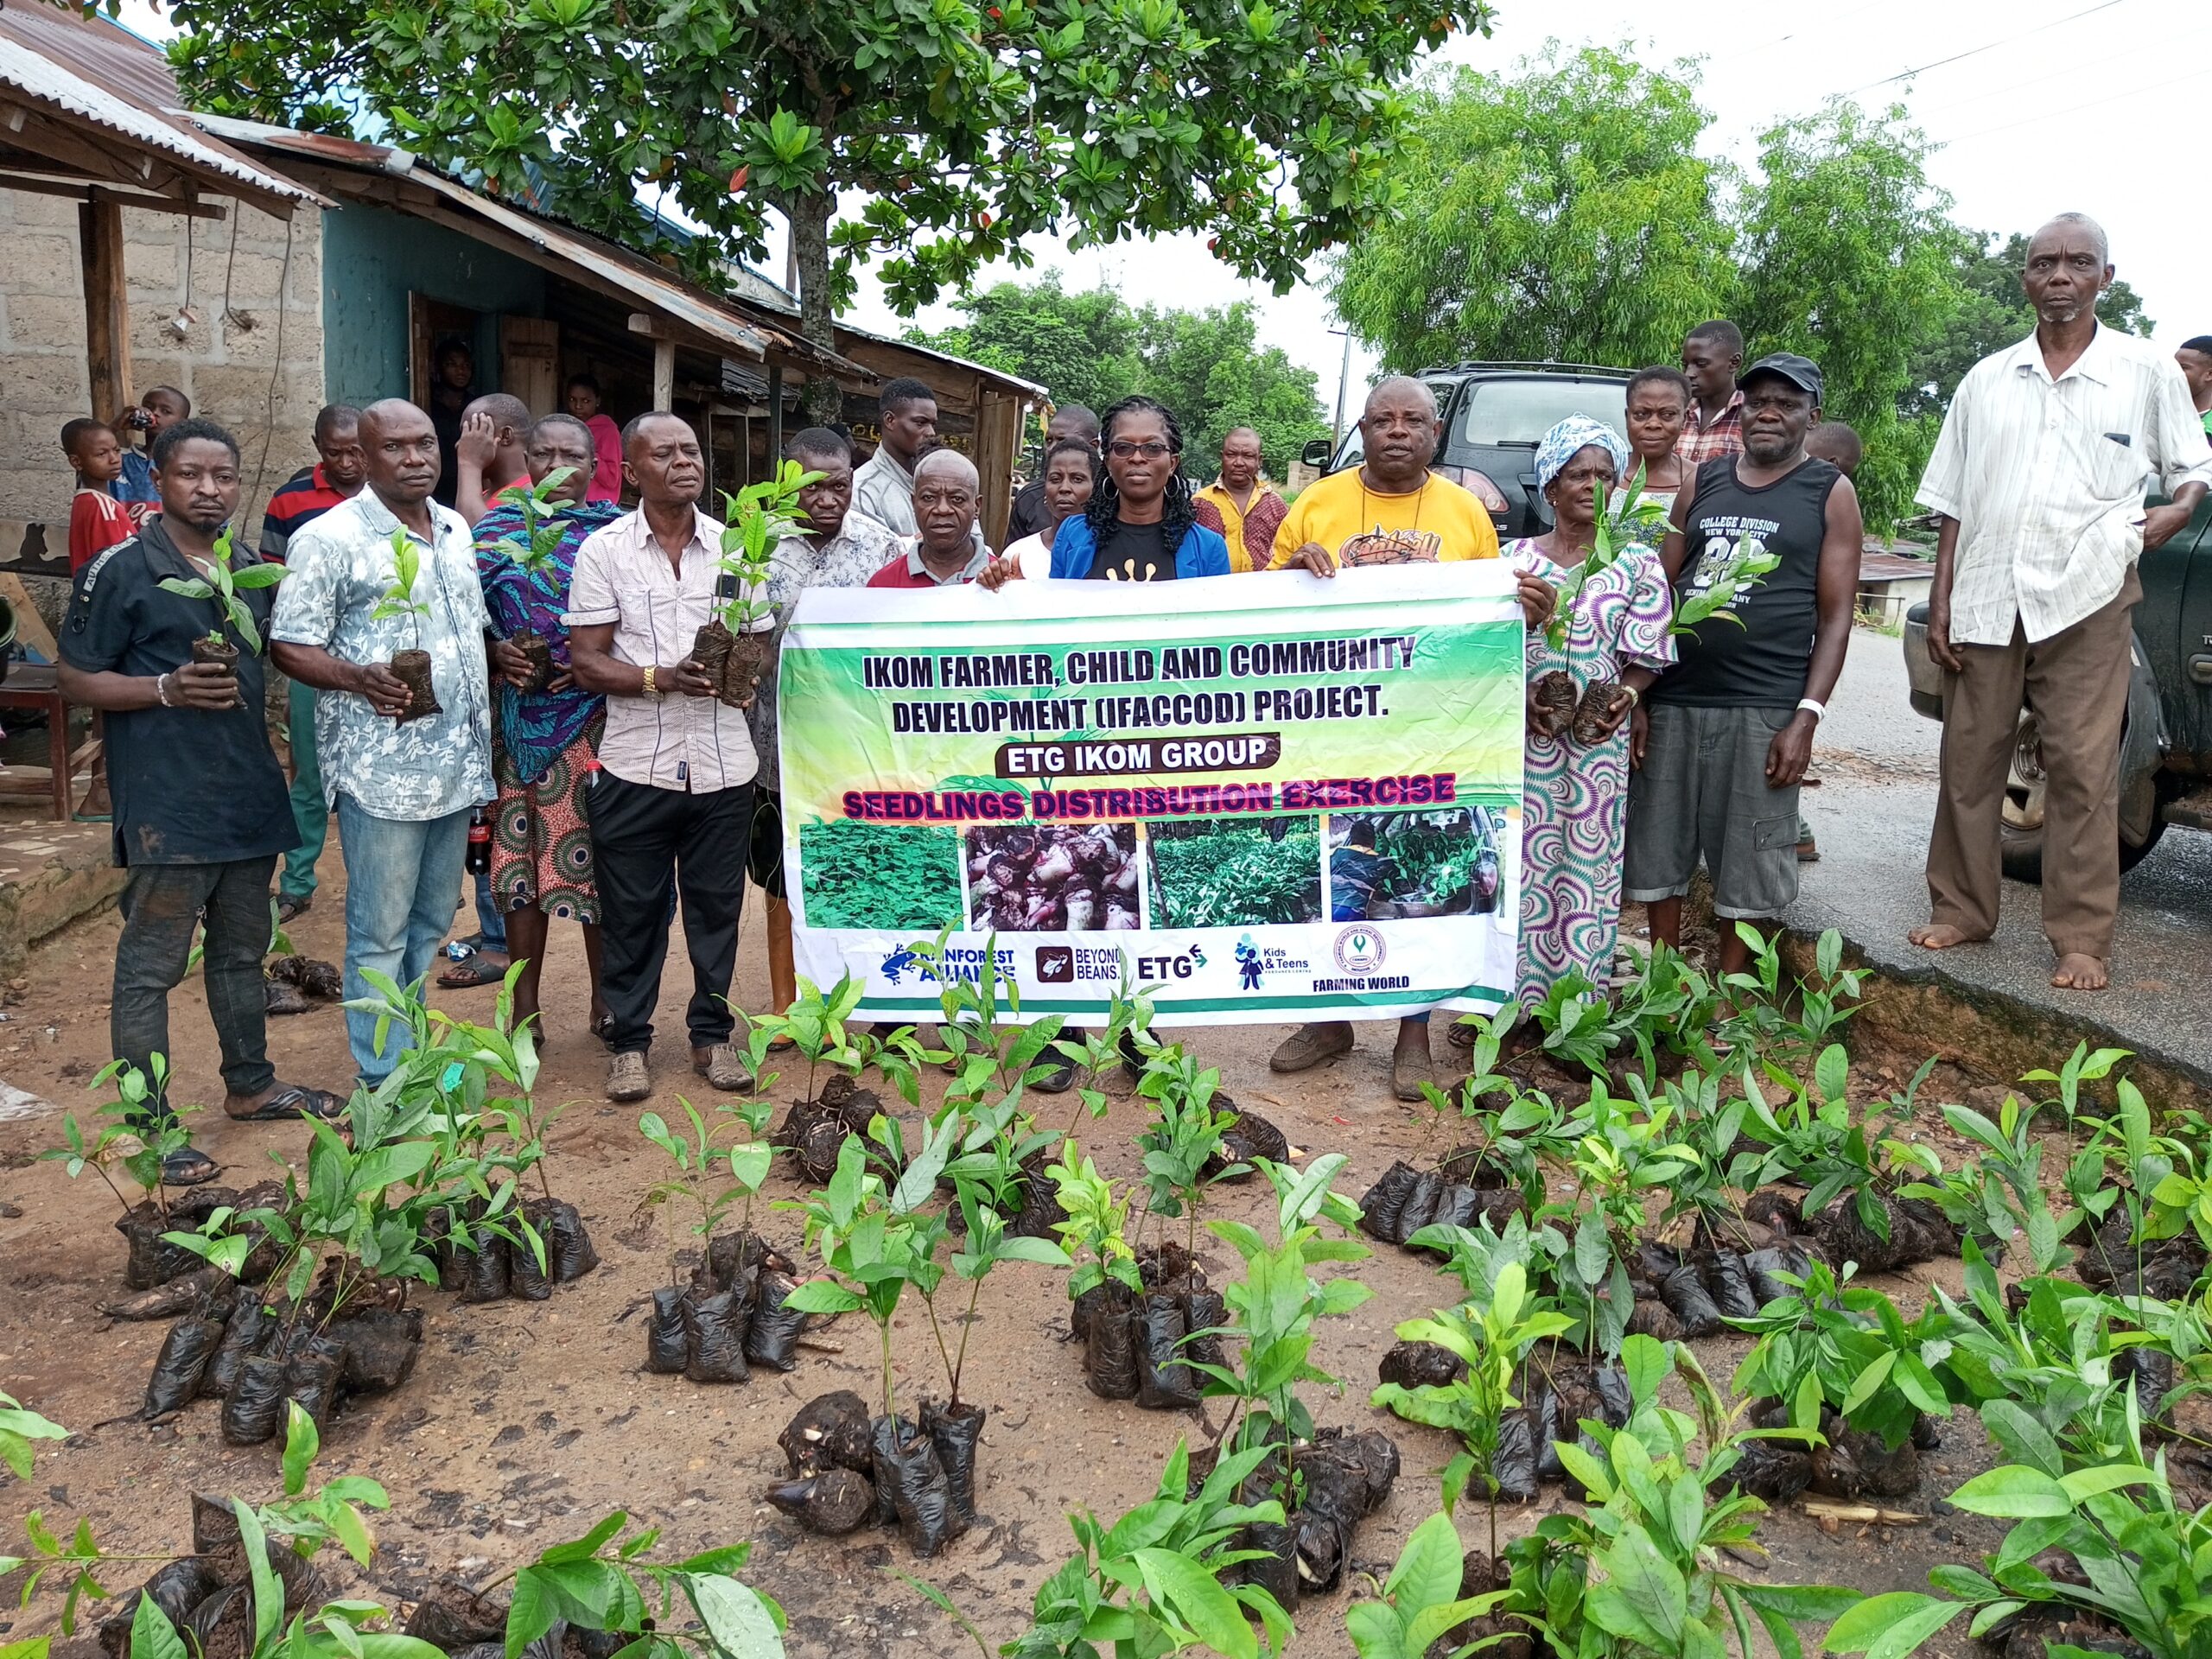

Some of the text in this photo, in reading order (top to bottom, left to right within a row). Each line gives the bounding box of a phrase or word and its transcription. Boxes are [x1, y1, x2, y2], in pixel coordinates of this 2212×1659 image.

[1699, 516, 1780, 533] COLLEGE DIVISION
[1705, 528, 1724, 537] NEW
[1749, 530, 1769, 539] CITY
[863, 636, 1416, 690] IKOM FARMER, CHILD AND COMMUNITY
[892, 698, 1088, 733] DEVELOPMENT
[1254, 683, 1389, 722] PROJECT.
[1007, 739, 1267, 772] ETG IKOM GROUP
[842, 772, 1456, 820] SEEDLINGS DISTRIBUTION EXERCISE
[1263, 947, 1287, 957] Kids
[1137, 956, 1192, 980] ETG
[1265, 957, 1309, 969] & Teens
[1077, 964, 1121, 980] BEANS.
[1313, 976, 1410, 992] FARMING WORLD
